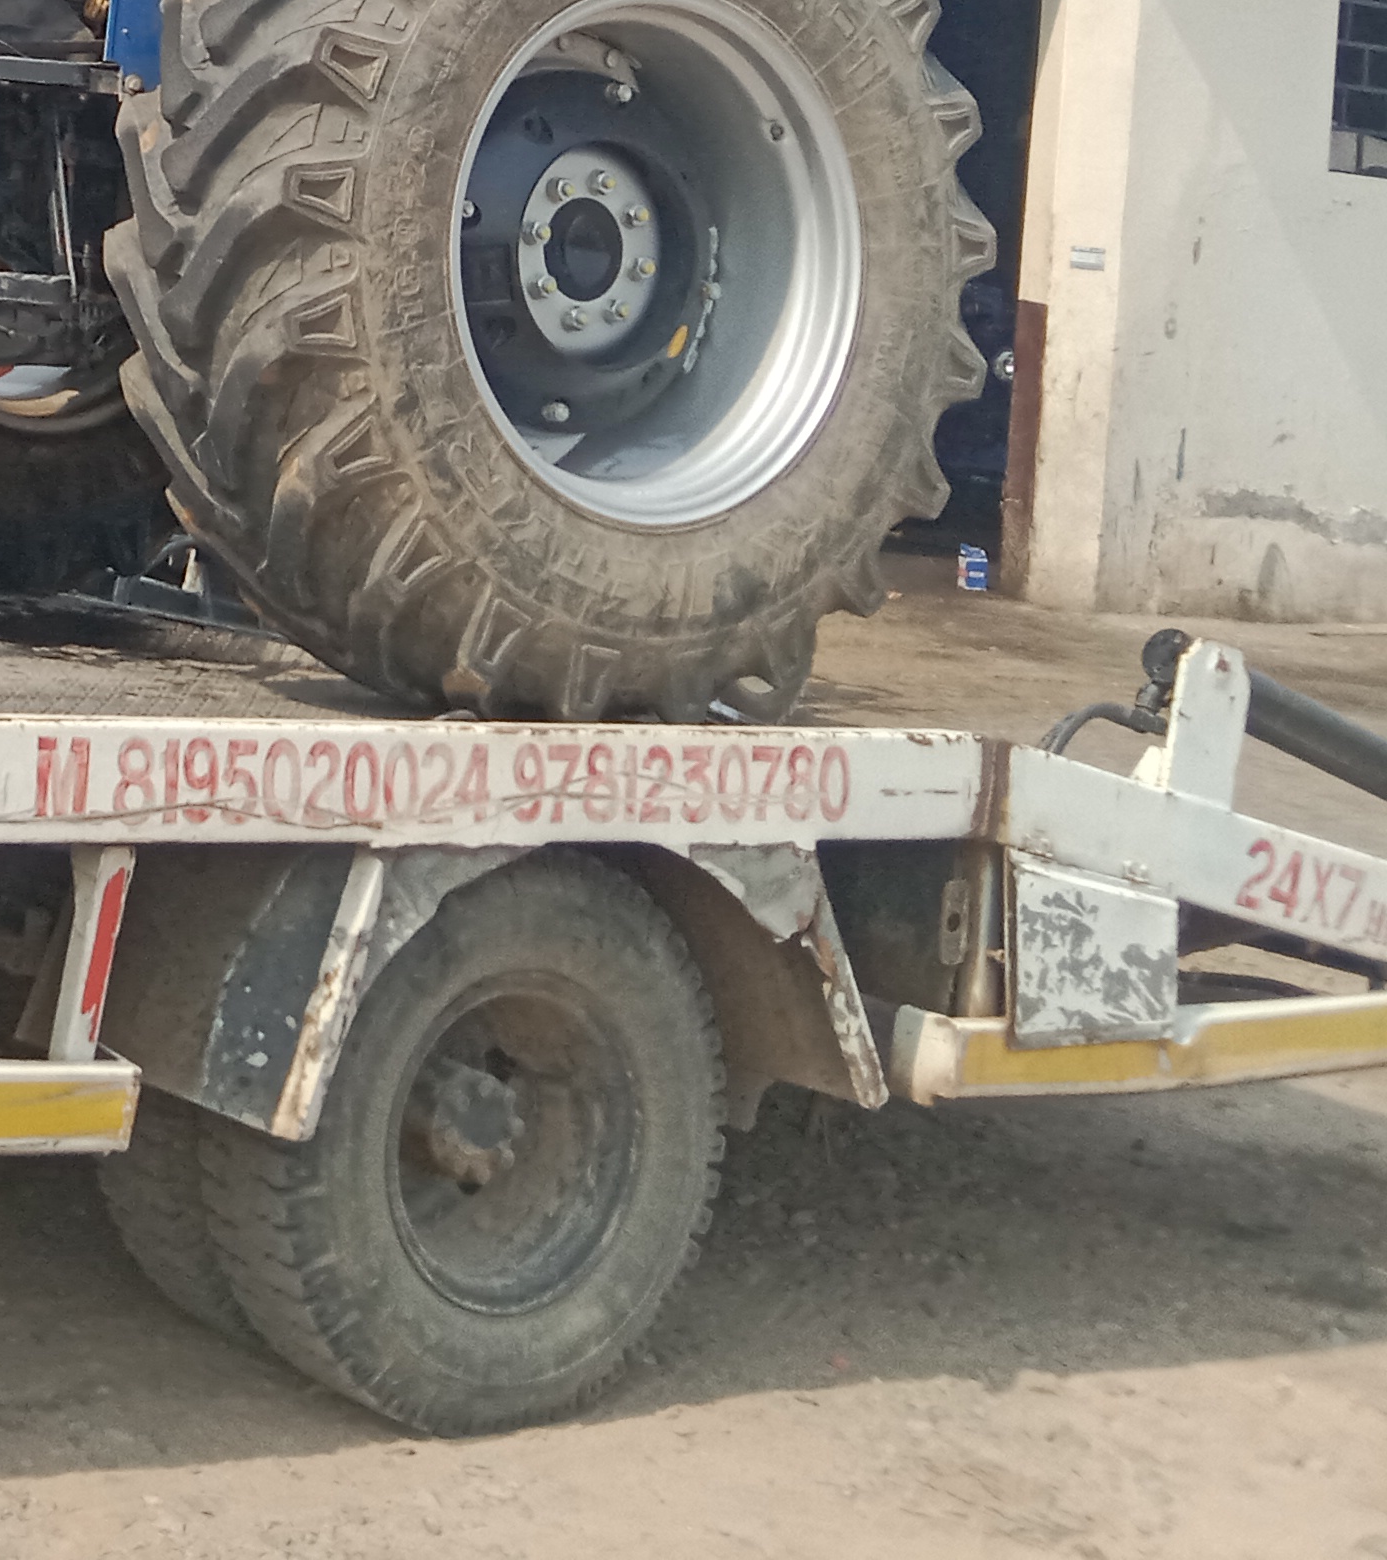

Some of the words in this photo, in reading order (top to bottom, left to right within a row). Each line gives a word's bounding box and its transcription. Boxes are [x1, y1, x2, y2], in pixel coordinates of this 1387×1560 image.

[113, 737, 490, 826] 8195020024
[513, 742, 851, 824] 9781230780
[1235, 838, 1368, 932] 24X7
